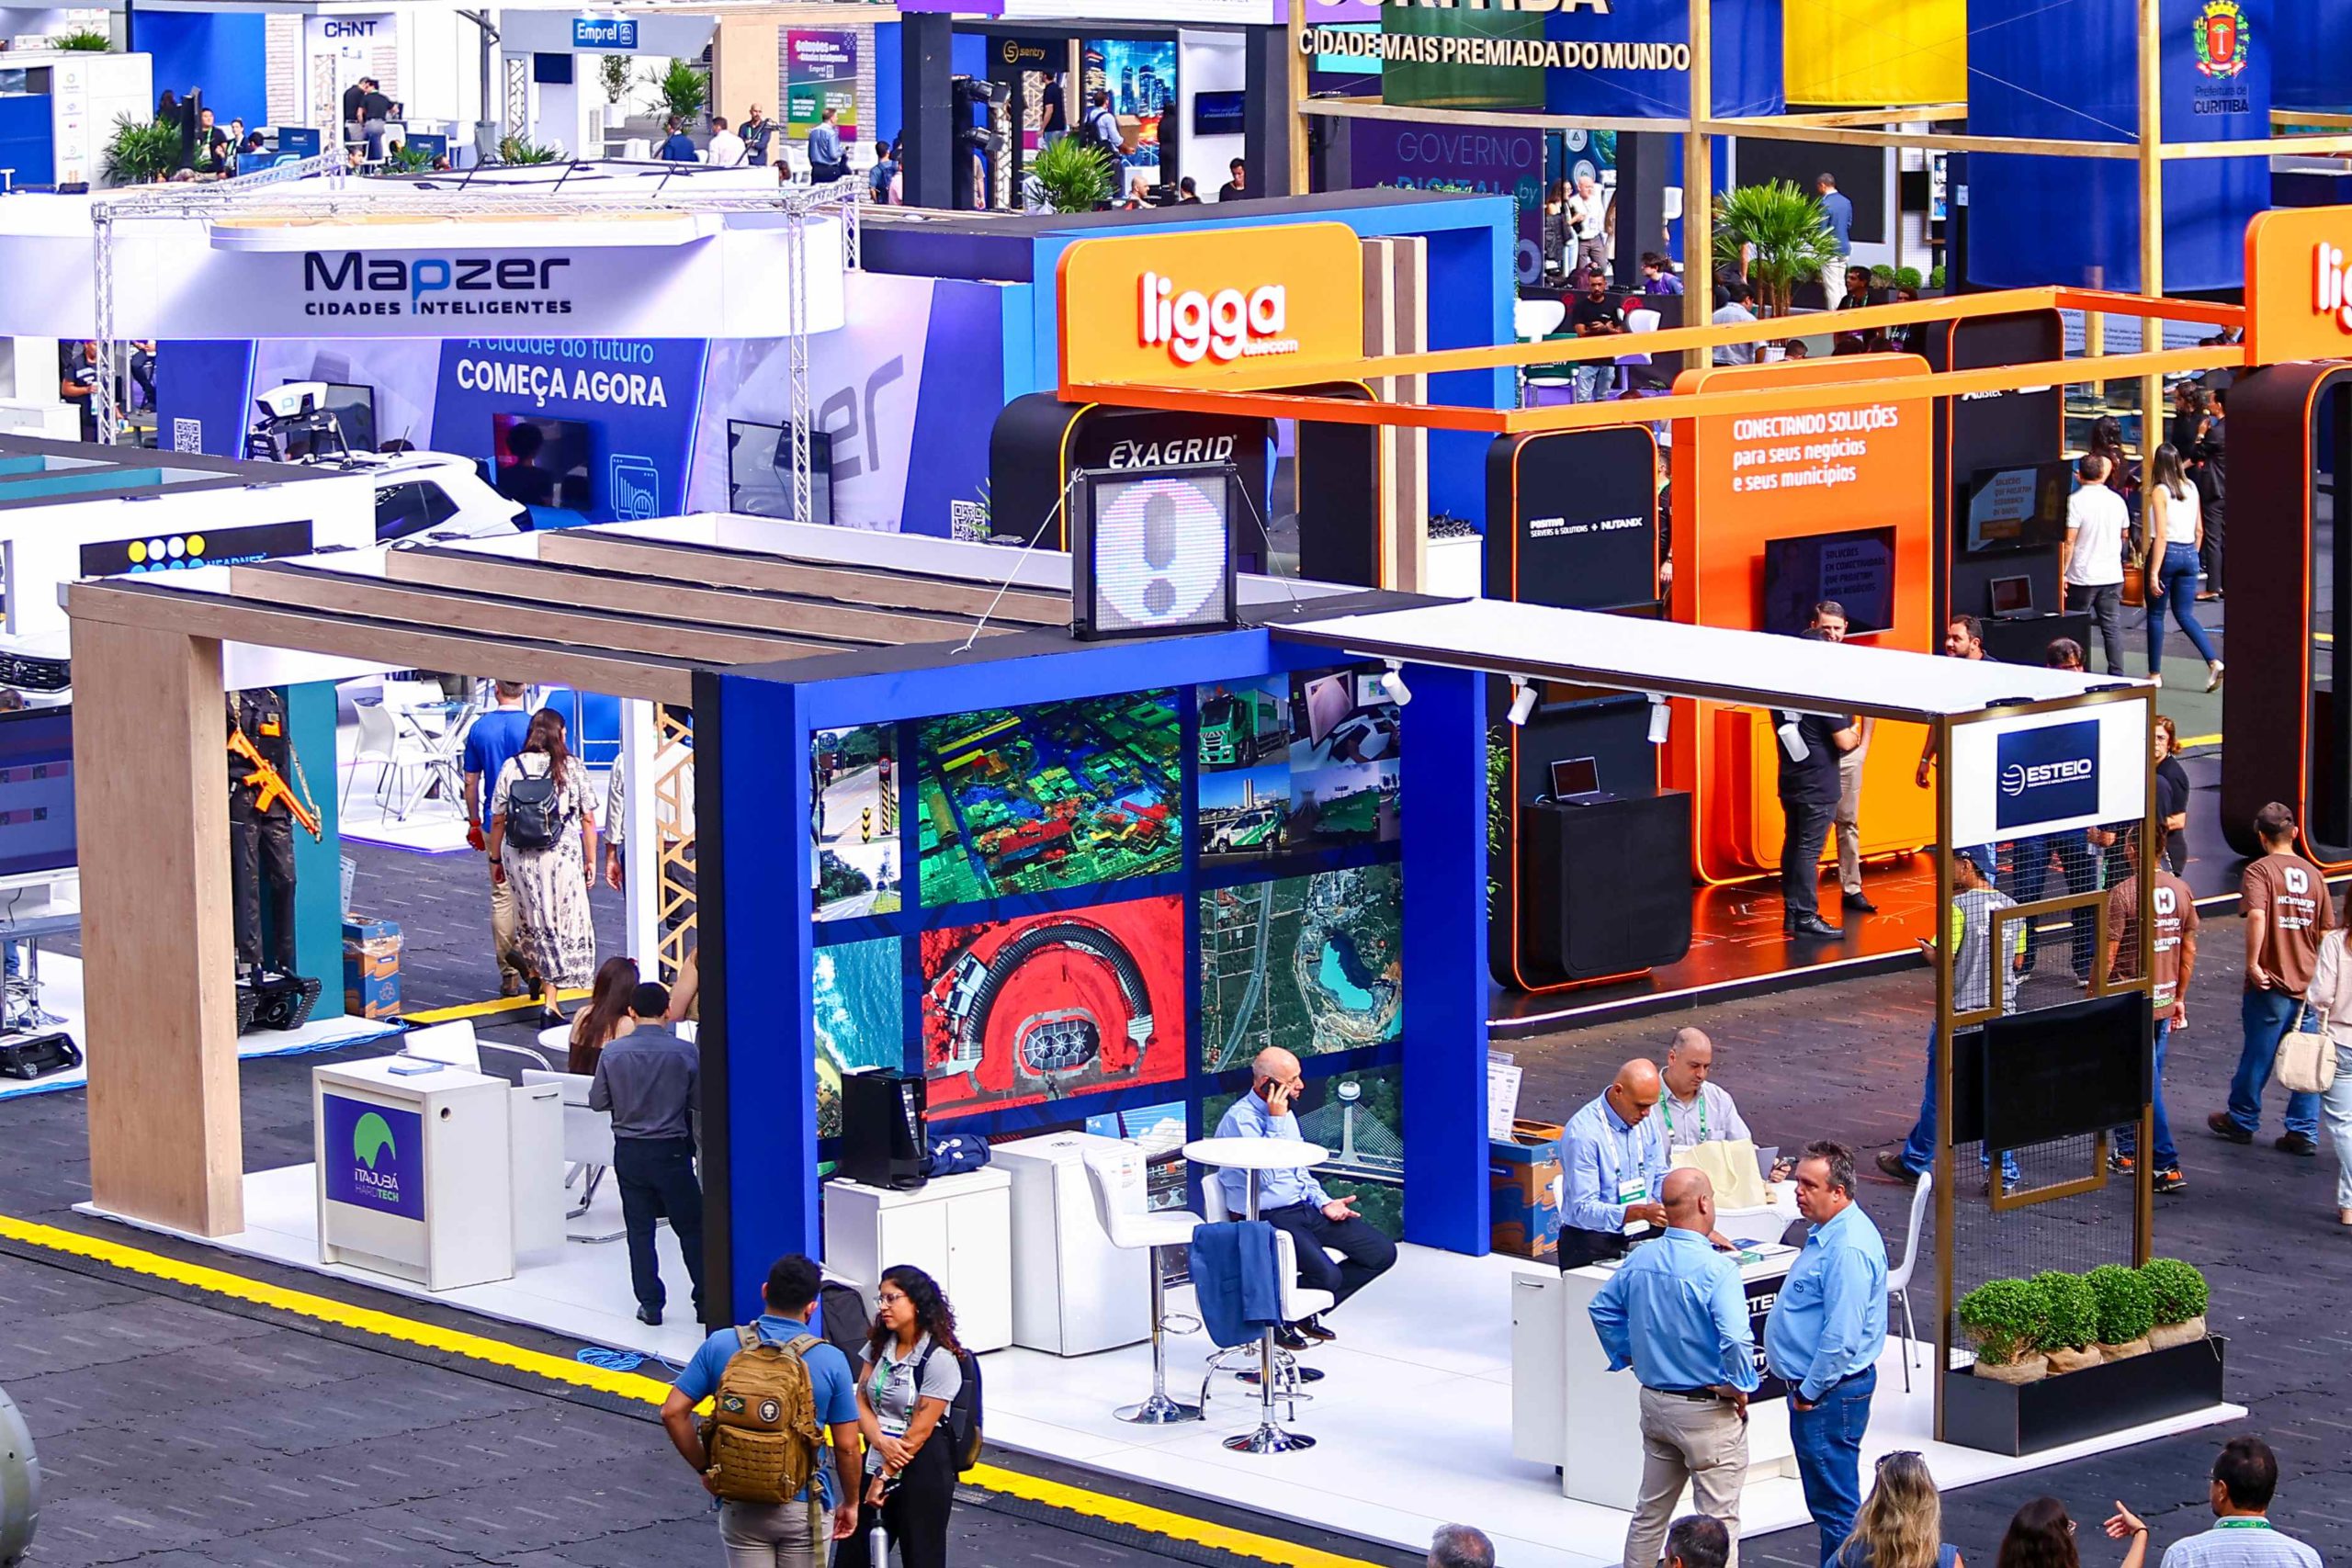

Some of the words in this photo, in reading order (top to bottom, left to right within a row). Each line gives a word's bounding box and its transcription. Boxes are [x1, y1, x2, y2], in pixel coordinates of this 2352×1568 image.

[577, 22, 617, 44] Emprel
[1299, 28, 1377, 58] CIDADE
[1382, 34, 1439, 62] MAIS
[1442, 38, 1561, 68] PREMIADA
[1565, 41, 1600, 70] DO
[1601, 43, 1691, 71] MUNDO
[2195, 85, 2235, 97] Prefeitura
[2194, 98, 2249, 114] CURITIBA
[1397, 131, 1532, 168] GOVERNO
[1519, 186, 1539, 204] by
[304, 251, 571, 301] Mapzer
[304, 301, 401, 316] CIDADES
[412, 299, 572, 315] INTELIGENTES
[1137, 270, 1286, 367] ligga
[1243, 338, 1299, 356] telecom
[457, 358, 568, 407] COMEÇA
[572, 369, 668, 408] AGORA
[1733, 412, 1826, 441] CONECTANDO
[1827, 404, 1899, 432] SOLUÇÕES
[1108, 435, 1234, 469] EXAGRID
[1733, 448, 1766, 470] para
[1769, 445, 1802, 463] seus
[1804, 437, 1867, 463] negócios
[1733, 476, 1743, 491] e
[1745, 473, 1778, 491] seus
[1530, 528, 1555, 537] SERVERS
[1560, 525, 1589, 535] SOLUTIONS
[1600, 517, 1643, 530] NUTANIX
[2027, 758, 2092, 783] ESTEIO
[355, 1168, 399, 1190] ITAJUBÁ
